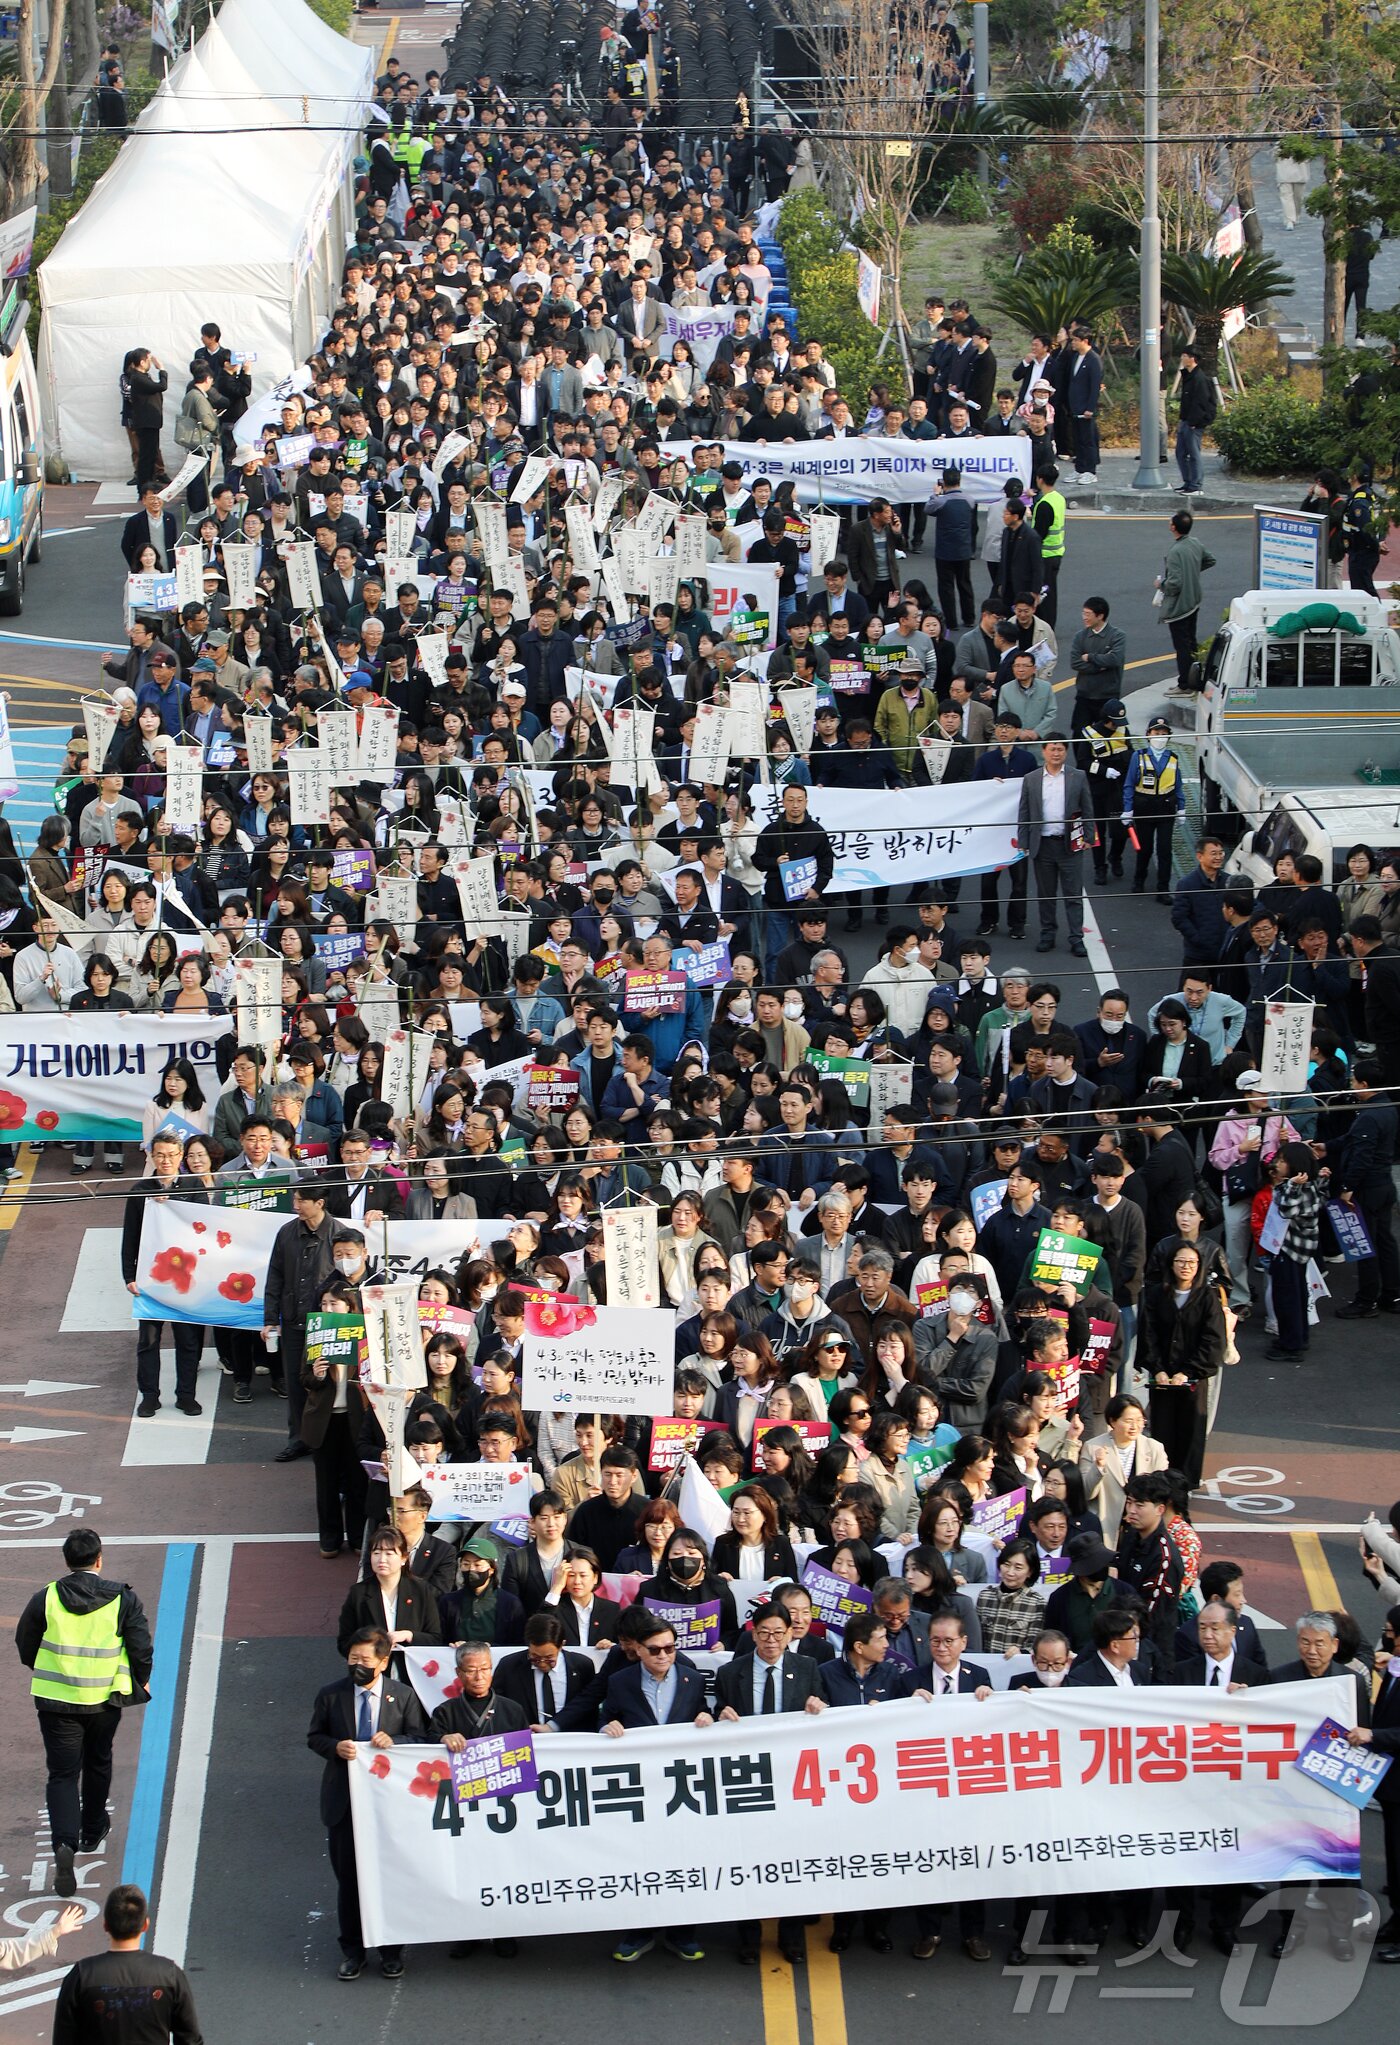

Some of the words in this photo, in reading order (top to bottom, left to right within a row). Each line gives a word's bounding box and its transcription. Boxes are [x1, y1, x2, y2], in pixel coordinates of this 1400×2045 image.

[741, 462, 783, 475] 4·3은
[790, 459, 855, 475] 세계인의
[861, 458, 927, 473] 기록이자
[156, 584, 174, 598] 4·3
[156, 595, 178, 609] 대행
[863, 647, 876, 655] 4·3
[210, 750, 239, 764] 대행
[173, 759, 182, 792] 처벌법
[186, 763, 195, 788] 4·3
[173, 797, 182, 818] 제정
[185, 791, 195, 813] 왜곡
[333, 851, 356, 866] 왜곡
[351, 860, 370, 871] 즉각
[330, 872, 363, 888] 정하라!
[784, 867, 804, 886] 4·3
[804, 859, 818, 876] 평
[333, 935, 363, 955] 평화
[676, 954, 699, 972] 4·3
[700, 944, 726, 966] 평화
[261, 968, 270, 991] 4·3
[629, 973, 669, 988] 제주4·3은
[247, 982, 258, 1031] 정신계승
[627, 994, 676, 1010] 역사입니다.
[6, 1043, 146, 1078] 거리에서
[389, 1056, 404, 1105] 정신계승
[532, 1070, 562, 1083] 제주4·3은
[844, 1071, 870, 1084] 즉각
[528, 1094, 569, 1107] 역사입니다.
[225, 1190, 263, 1205] 특별법
[232, 1196, 278, 1210] 정하라!
[975, 1189, 1000, 1212] 4·3
[1039, 1235, 1065, 1251] 4·3
[1037, 1249, 1079, 1269] 특별법
[1076, 1254, 1099, 1272] 즉각
[1033, 1264, 1093, 1285] 개정하라!
[529, 1293, 558, 1304] 4·3은
[920, 1285, 949, 1305] 제주4
[395, 1296, 405, 1328] 4·3
[418, 1306, 455, 1321] 주4·3은
[307, 1316, 322, 1331] 4·3
[306, 1328, 338, 1347] 특별법
[336, 1326, 366, 1341] 즉각
[396, 1332, 413, 1361] 항쟁
[566, 1347, 597, 1368] 역사는
[599, 1349, 635, 1368] 평화를
[637, 1347, 666, 1370] 품고,
[533, 1366, 565, 1382] 역사의
[568, 1367, 593, 1385] 기록은
[597, 1368, 628, 1387] 인권을
[628, 1369, 666, 1388] 밝히다
[387, 1401, 395, 1434] 4·3
[655, 1424, 706, 1440] 제주4·3은
[914, 1455, 939, 1476] 4·3
[448, 1471, 481, 1482] 4·3의
[484, 1471, 507, 1483] 진실,
[452, 1483, 482, 1493] 우리가
[484, 1482, 505, 1493] 함께
[453, 1493, 504, 1505] 지켜갑니다
[974, 1496, 1012, 1524] 4·3왜곡
[980, 1512, 1006, 1536] 벌법
[1005, 1501, 1025, 1521] 즉각
[496, 1519, 529, 1542] 대행
[803, 1570, 852, 1598] 4·3왜곡
[838, 1597, 868, 1614] 즉각
[690, 1613, 719, 1633] 즉각
[810, 1605, 852, 1628] 정하라!
[675, 1632, 707, 1650] 하라!
[452, 1736, 505, 1767] 4·3왜곡
[455, 1755, 500, 1784] 처벌법
[500, 1746, 532, 1768] 즉각
[1302, 1749, 1345, 1782] 평화
[536, 1763, 645, 1830] 왜곡
[664, 1752, 776, 1817] 처벌
[792, 1743, 880, 1807] 4·3
[896, 1728, 1062, 1798] 특별법
[1079, 1722, 1300, 1786] 개정촉구
[1339, 1767, 1376, 1794] 4·3
[457, 1772, 522, 1802] 제정하라!
[480, 1866, 708, 1908] 5·18민주유공자유족회
[730, 1845, 980, 1887] 5·18민주화운동부상자회
[1002, 1827, 1240, 1866] 5·18민주화운동공로자회
